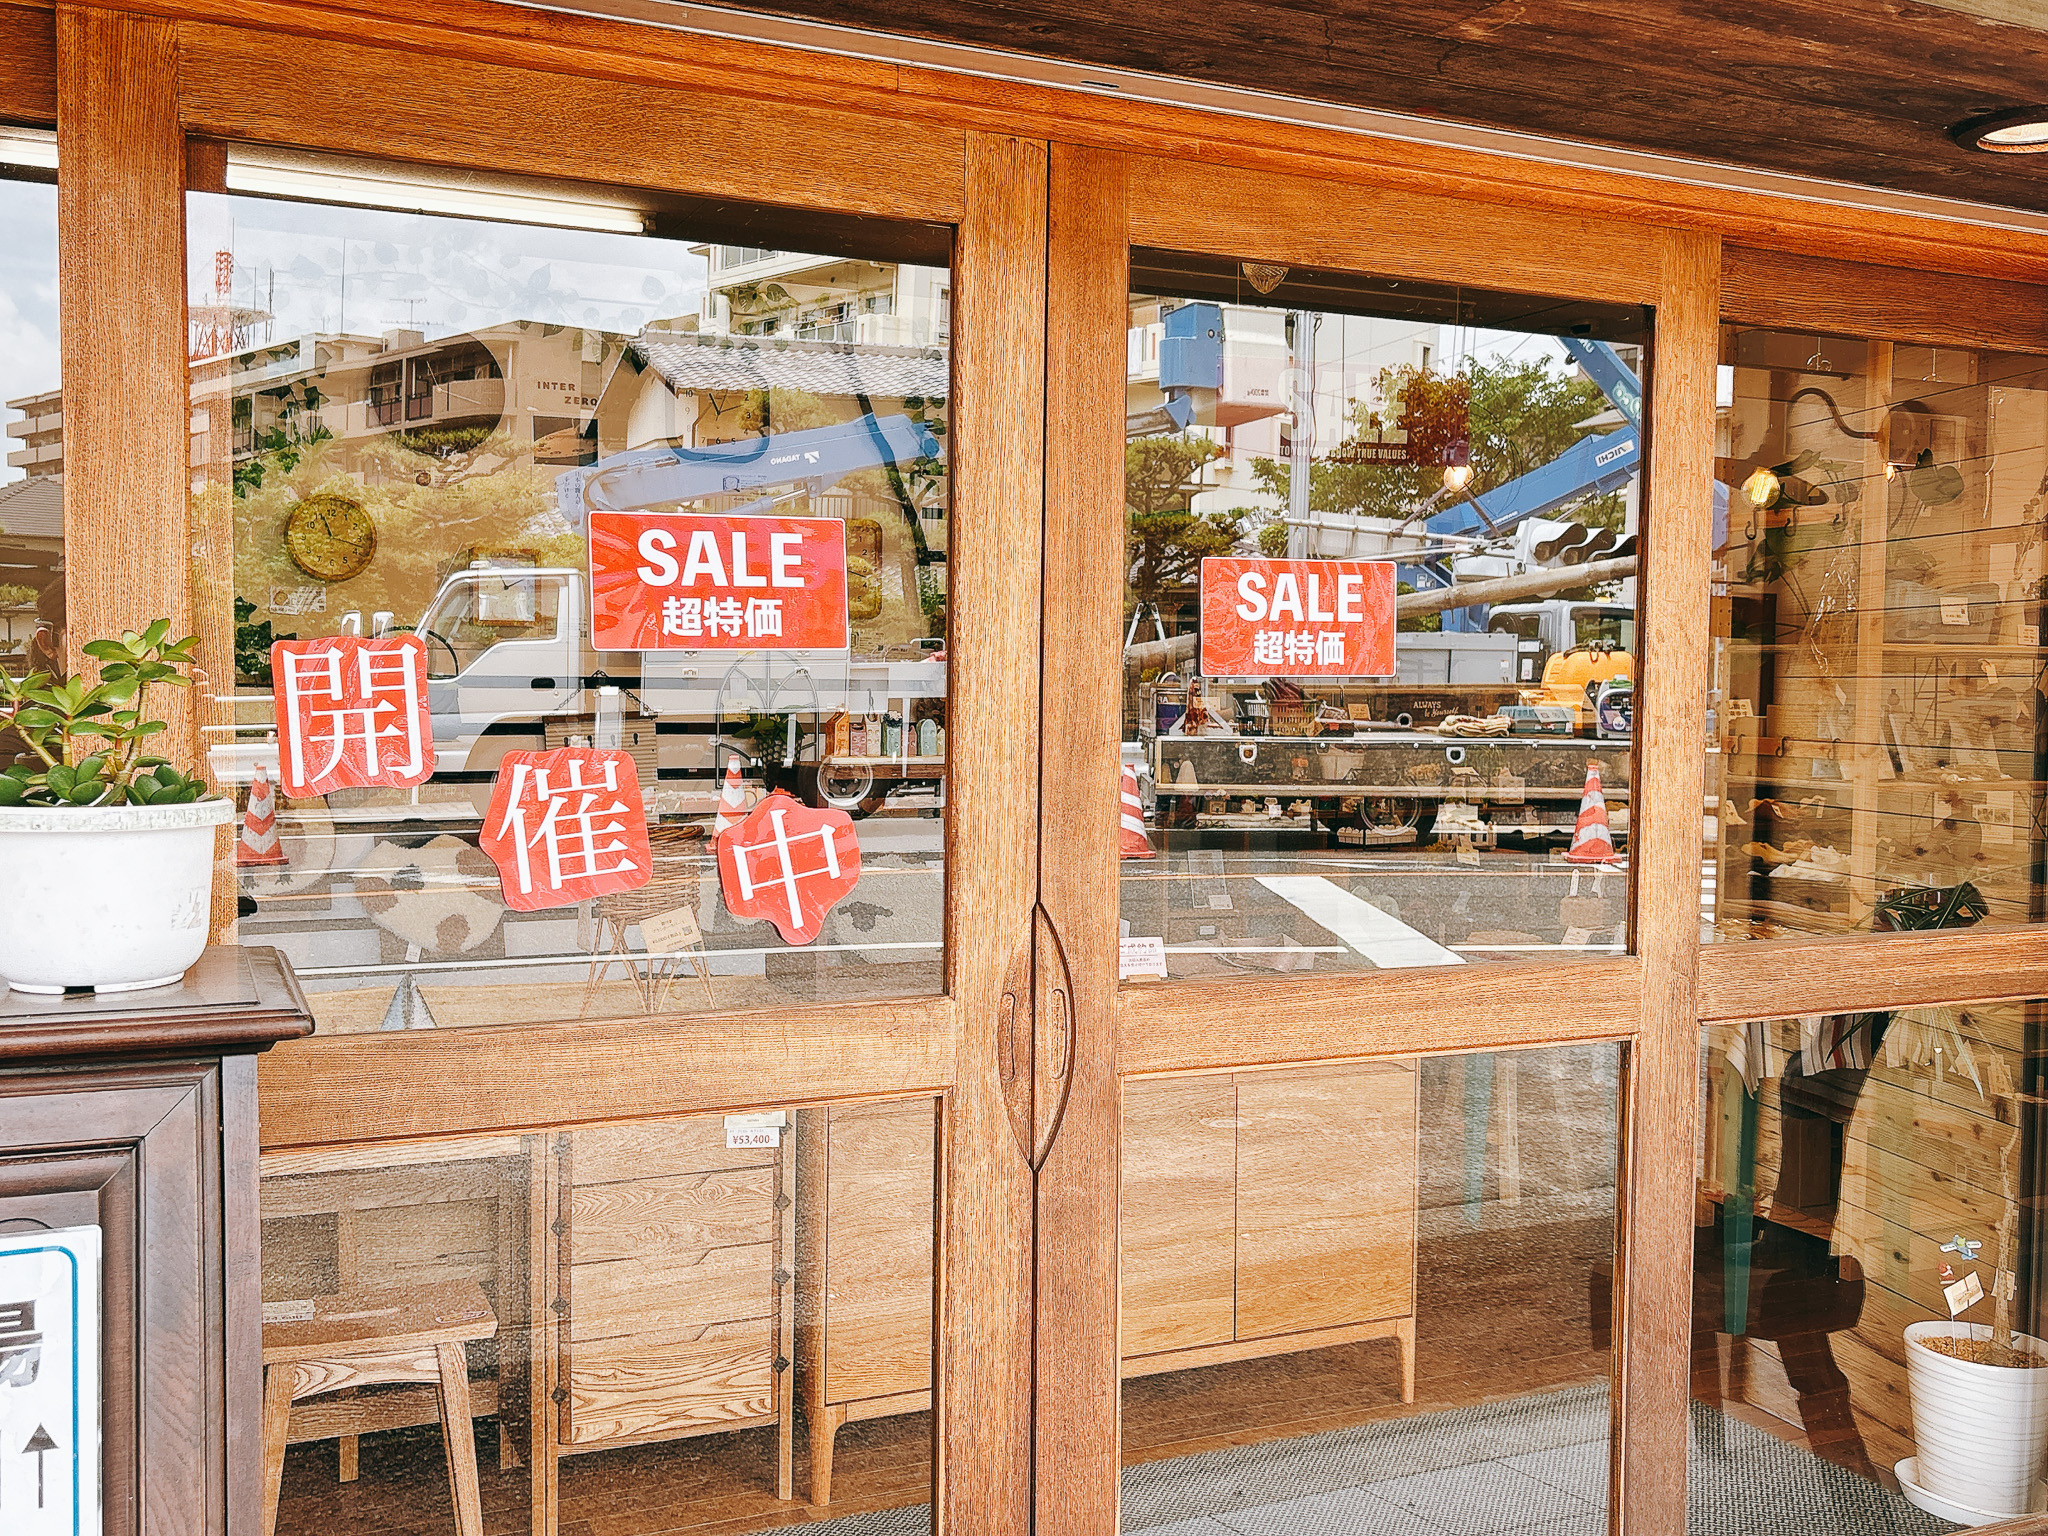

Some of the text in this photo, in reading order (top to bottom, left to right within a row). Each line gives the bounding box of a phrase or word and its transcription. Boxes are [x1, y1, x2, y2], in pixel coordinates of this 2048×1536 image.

[537, 381, 576, 391] INTER
[565, 396, 598, 406] ZERO
[1278, 368, 1408, 444] SALE
[1280, 445, 1290, 456] TO
[1357, 448, 1376, 459] TRUE
[636, 529, 805, 588] SALE
[1235, 571, 1363, 622] SALE
[662, 595, 783, 638] 超特価
[1253, 630, 1346, 666] 超特価
[1413, 701, 1442, 709] ALWAYS
